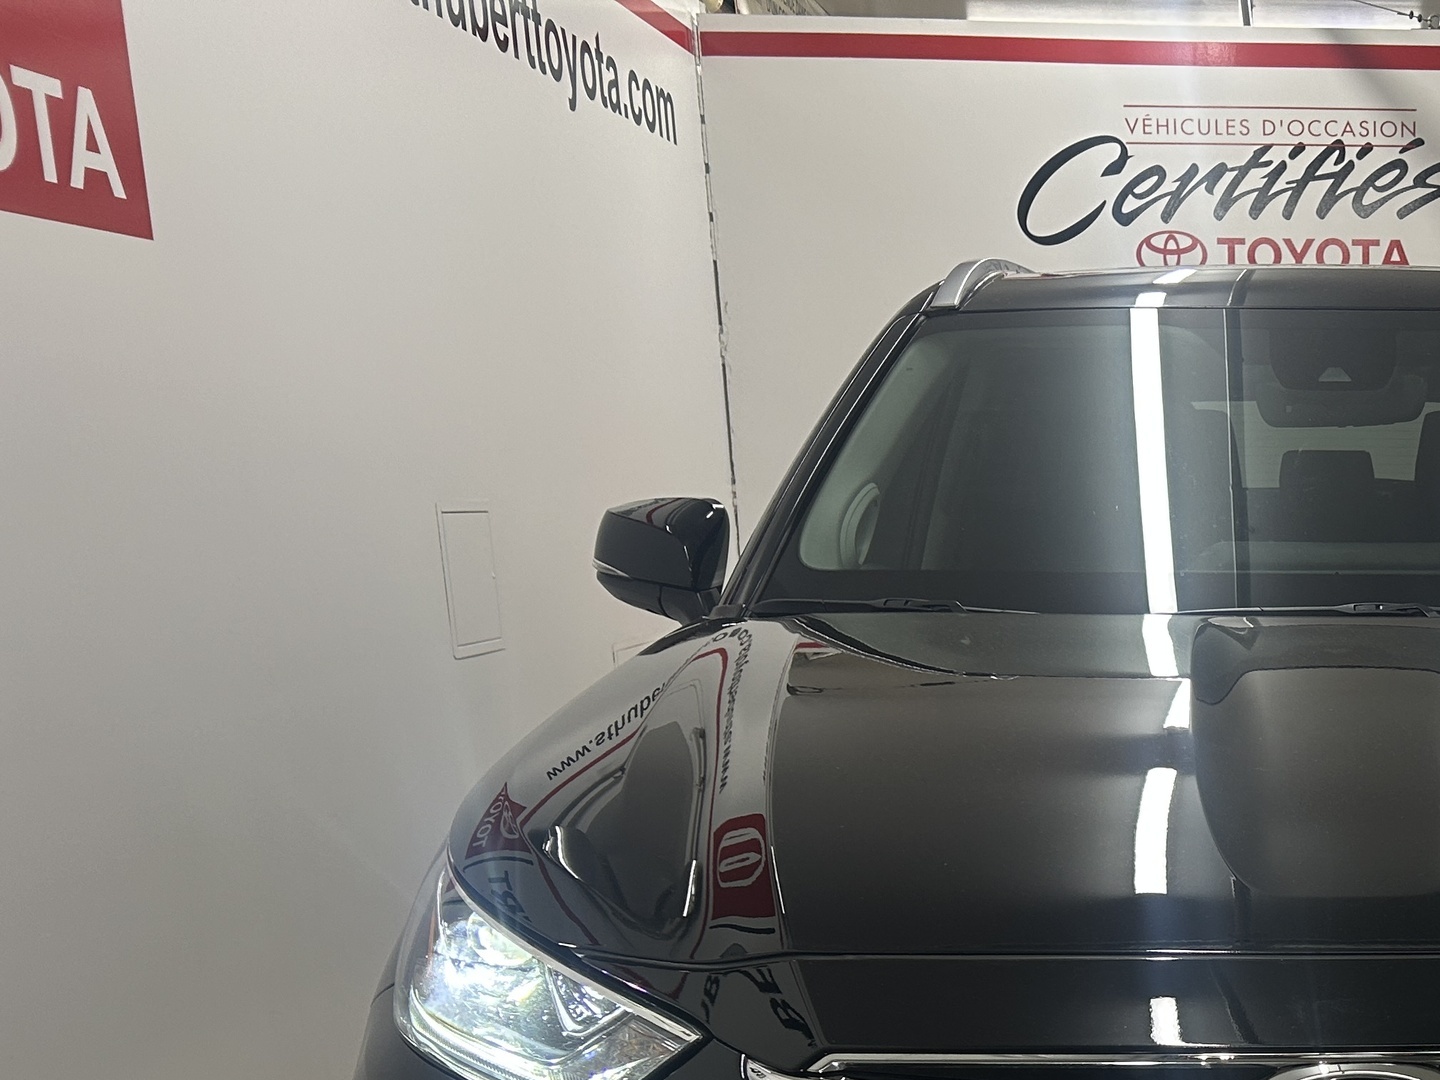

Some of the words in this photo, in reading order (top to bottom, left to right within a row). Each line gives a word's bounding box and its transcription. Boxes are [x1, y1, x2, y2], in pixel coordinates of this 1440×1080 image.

[1124, 113, 1250, 137] VÉHICULES
[1262, 118, 1418, 139] D'OCCASION
[1216, 236, 1410, 266] TOYOTA
